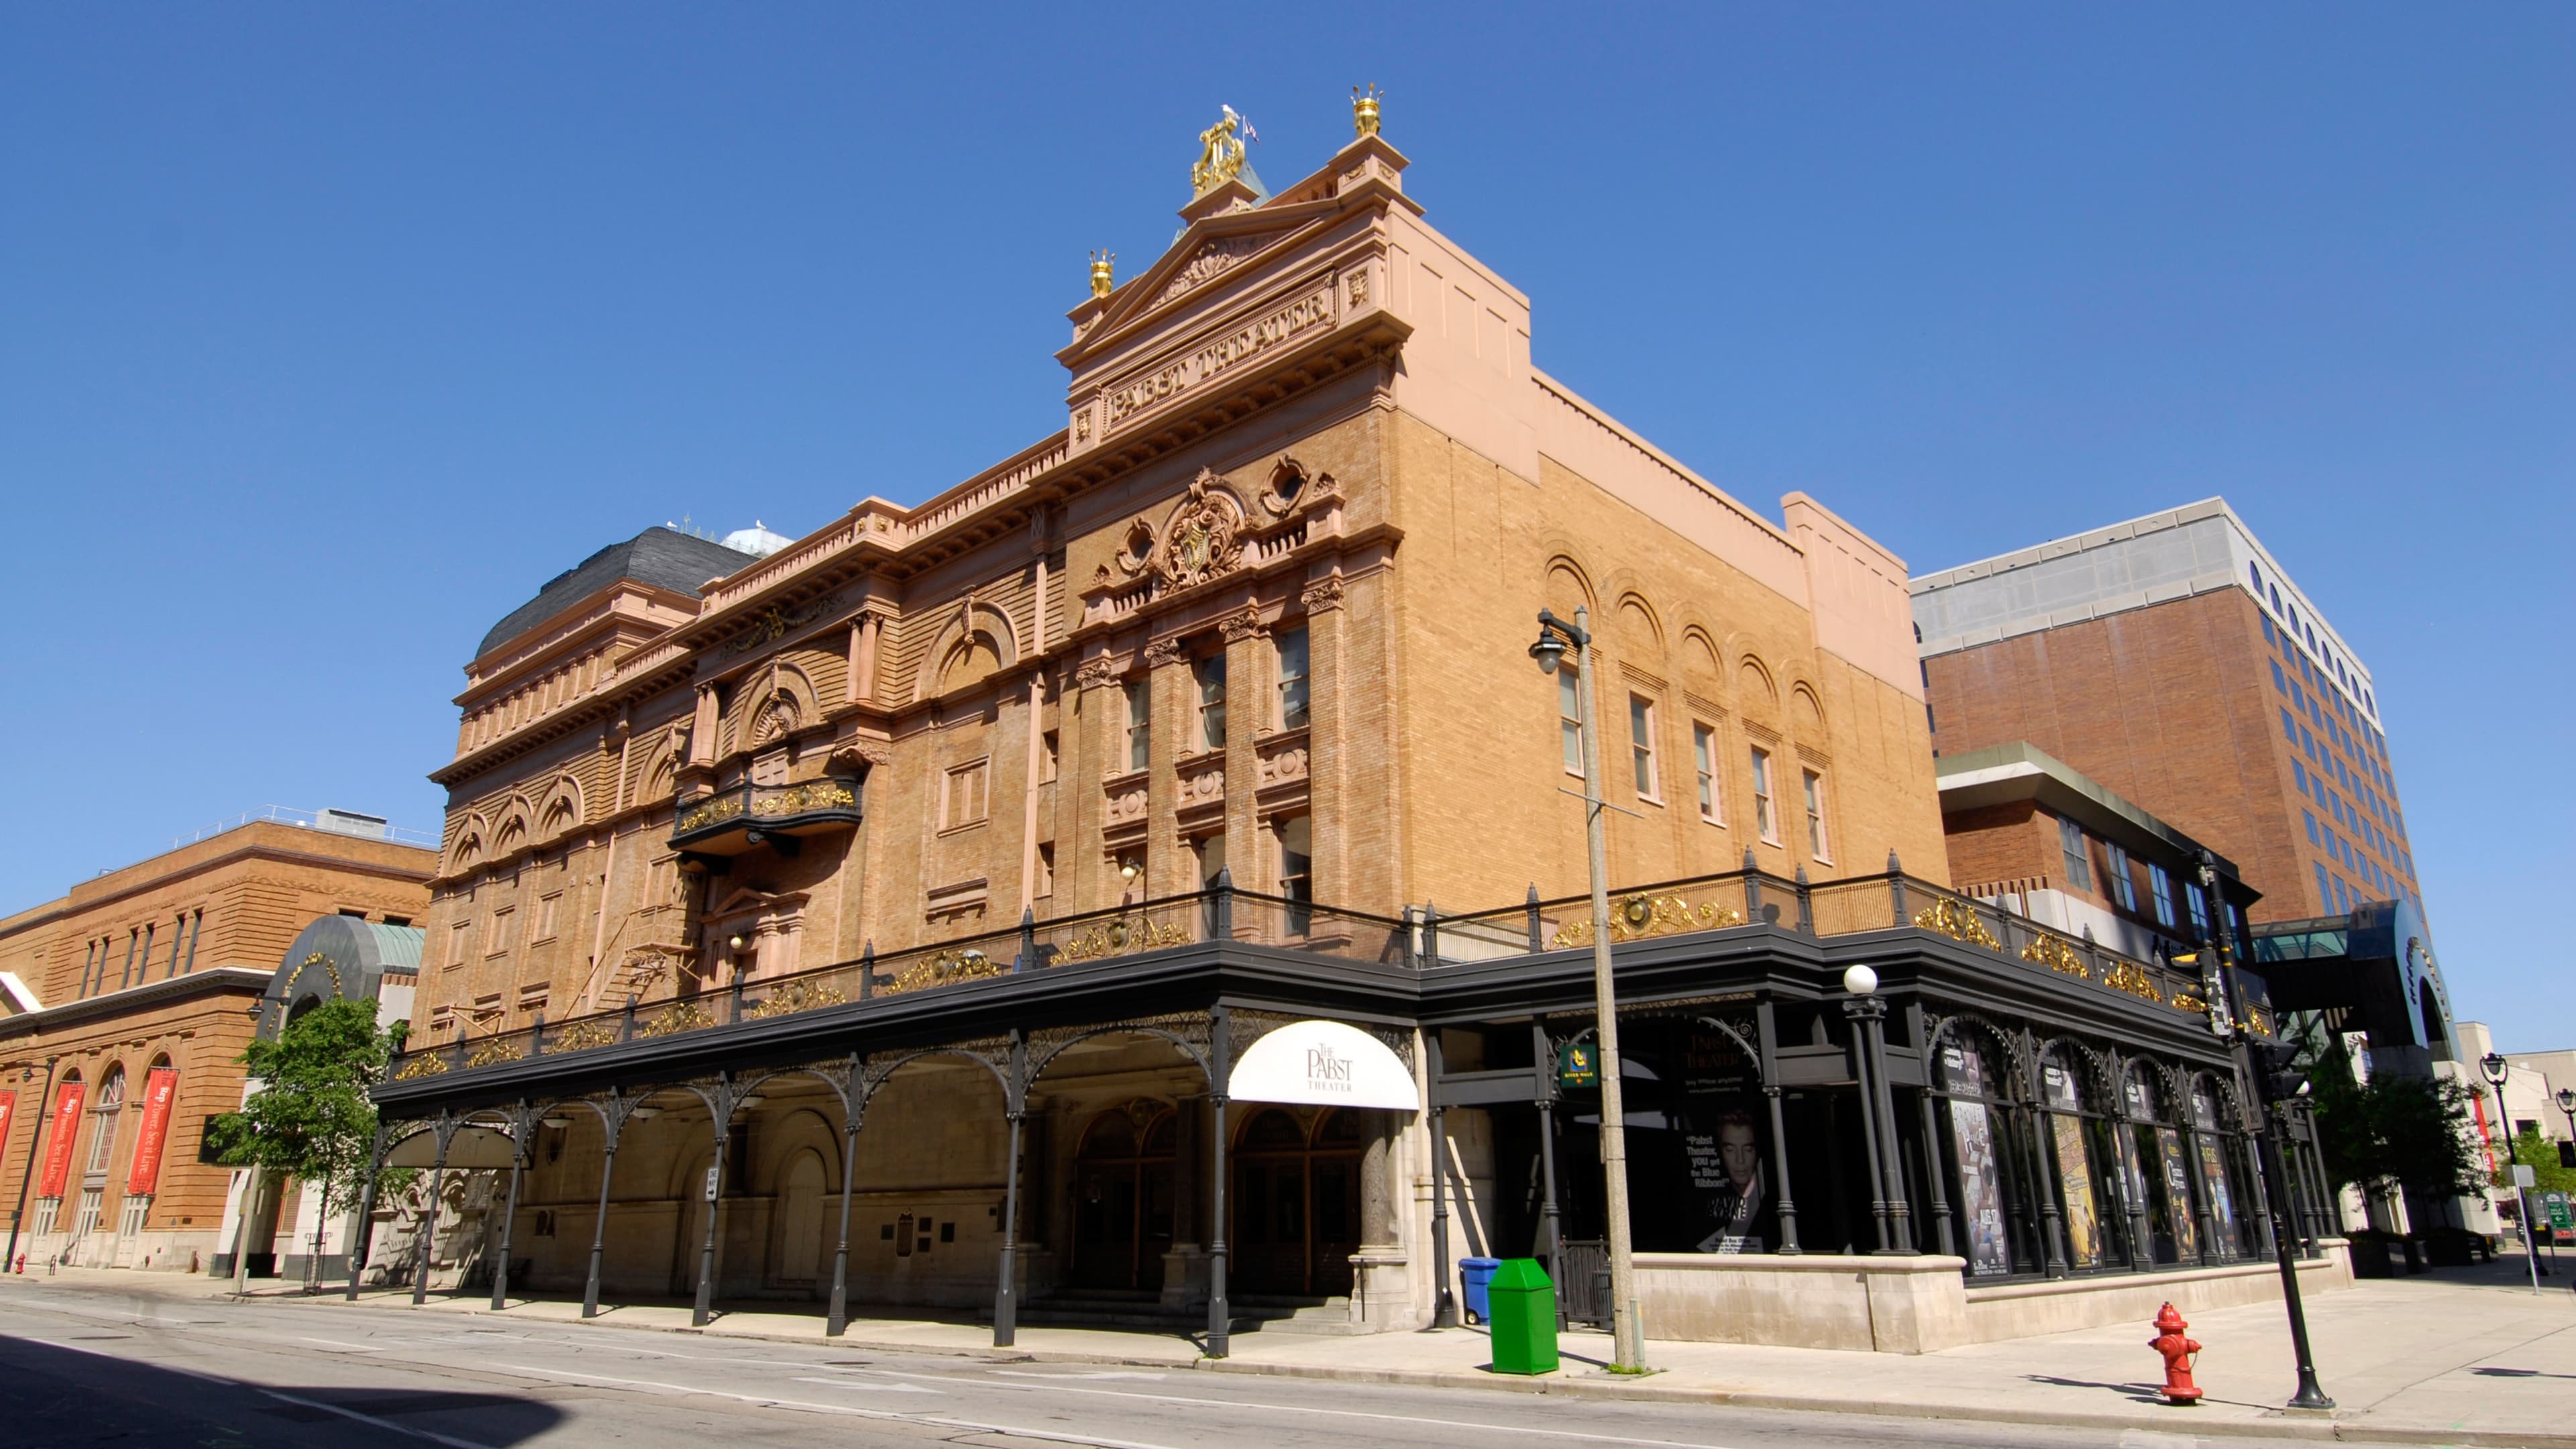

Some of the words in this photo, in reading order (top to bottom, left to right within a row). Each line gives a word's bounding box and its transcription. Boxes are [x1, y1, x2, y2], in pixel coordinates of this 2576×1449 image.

[1110, 360, 1188, 421] PABST
[1196, 293, 1328, 378] THEATER
[1307, 1049, 1352, 1081] PABST
[1308, 1081, 1352, 1092] THEATER
[155, 1086, 170, 1103] Rep
[63, 1099, 76, 1114] Rep
[148, 1104, 166, 1128] Power.
[57, 1114, 72, 1141] Passion.
[144, 1132, 160, 1146] See
[54, 1144, 66, 1156] See
[1686, 1146, 1717, 1157] Theater,
[139, 1155, 154, 1175] Live.
[1709, 1158, 1721, 1167] get
[49, 1164, 62, 1181] Live.
[1690, 1169, 1701, 1177] the
[1702, 1167, 1720, 1177] Blue
[1707, 1196, 1746, 1208] DAVID
[1707, 1208, 1747, 1220] BYRNE
